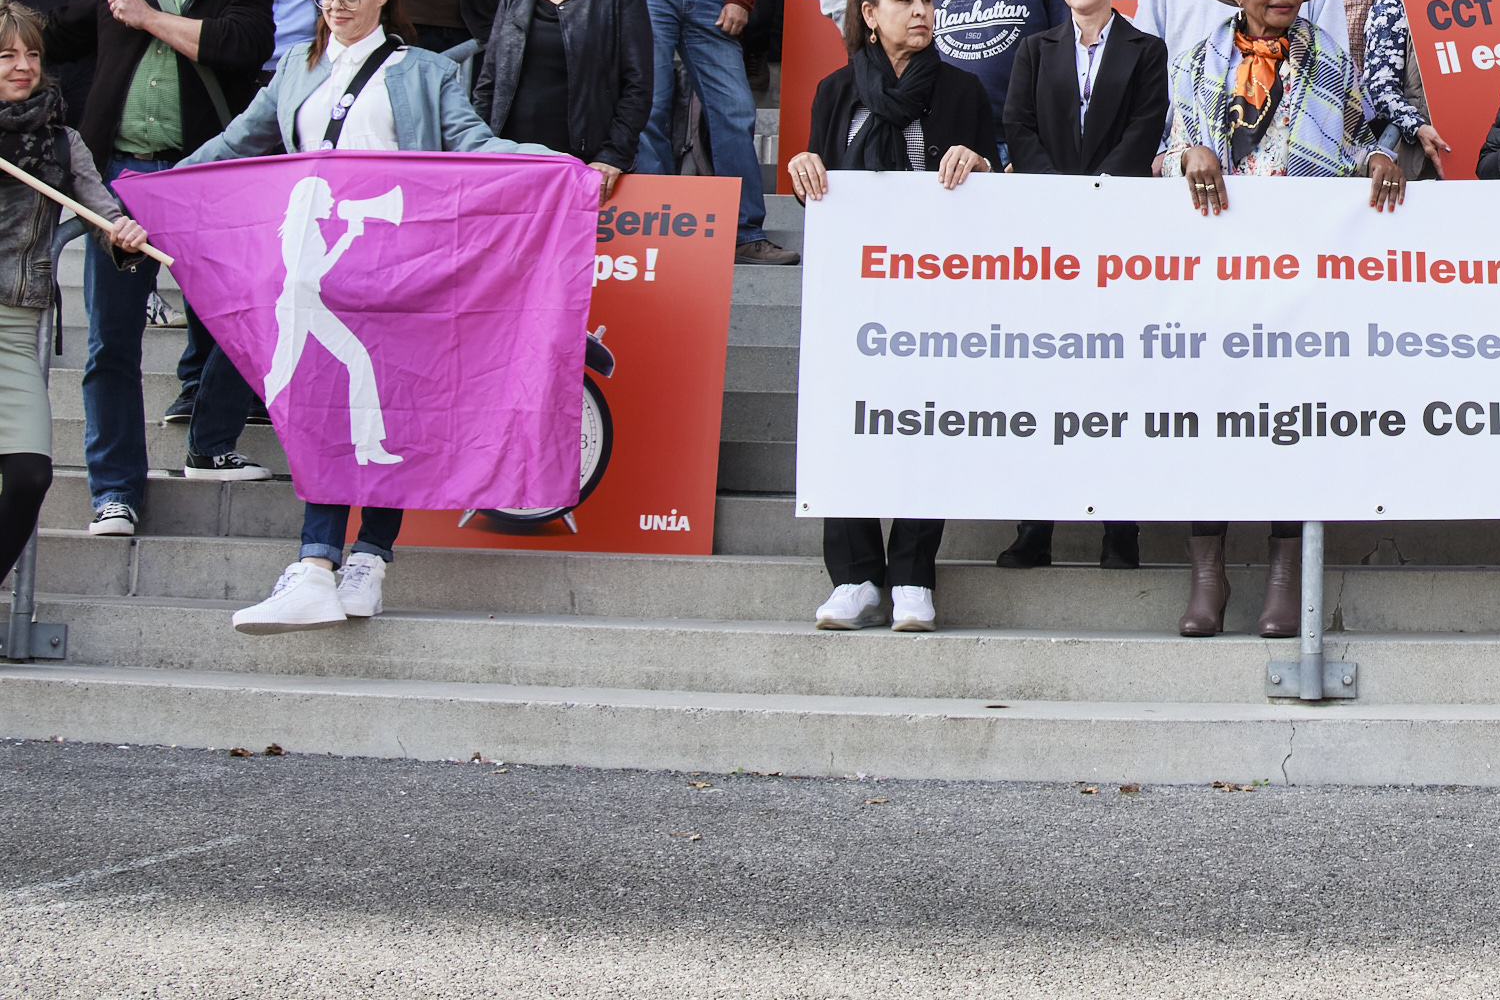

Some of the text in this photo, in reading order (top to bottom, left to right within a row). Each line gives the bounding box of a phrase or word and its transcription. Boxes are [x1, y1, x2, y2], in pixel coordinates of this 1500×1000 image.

[933, 0, 1030, 30] Manhattan
[950, 50, 982, 60] FASHION
[982, 26, 1021, 58] EXCELLENCY
[1435, 40, 1462, 75] il
[861, 246, 1081, 281] Ensemble
[1098, 254, 1200, 287] pour
[1216, 253, 1299, 281] une
[856, 322, 1124, 359] Gemeinsam
[1140, 322, 1206, 359] für
[1222, 323, 1350, 358] einen
[854, 400, 1037, 438] Insieme
[1053, 409, 1128, 445] per
[1145, 409, 1199, 439] un
[1217, 402, 1406, 445] migliore
